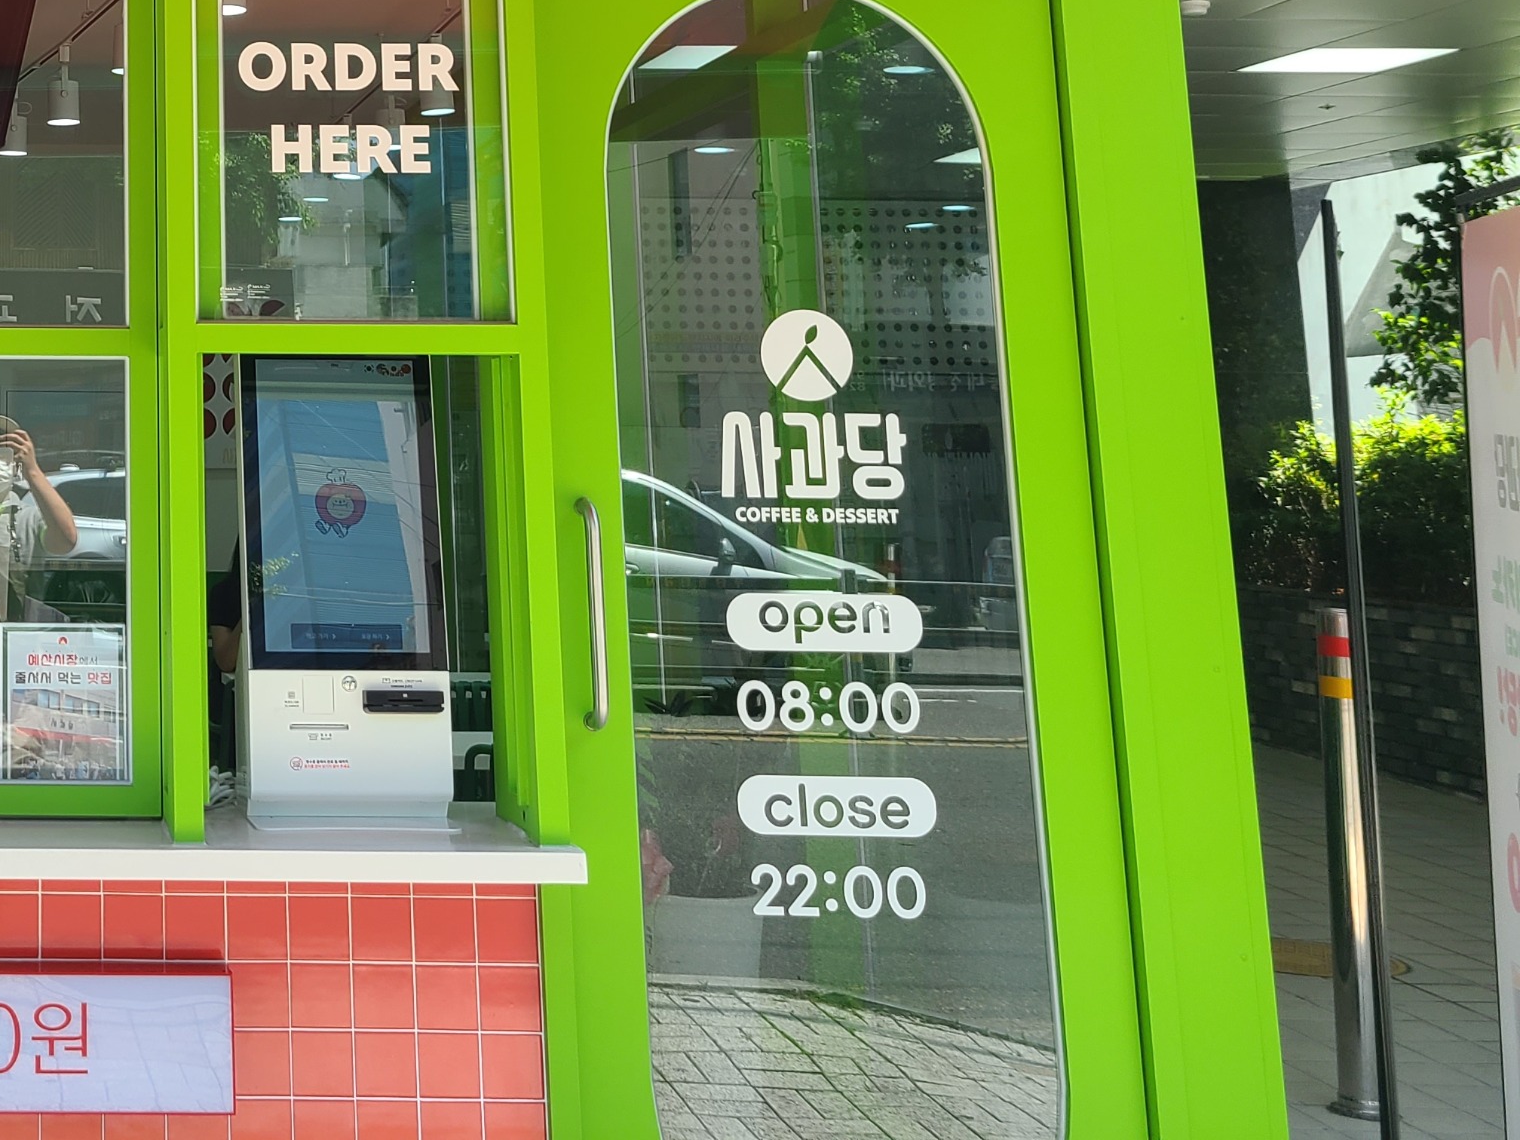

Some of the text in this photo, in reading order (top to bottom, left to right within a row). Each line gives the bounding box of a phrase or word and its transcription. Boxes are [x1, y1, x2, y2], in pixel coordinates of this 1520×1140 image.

[238, 41, 460, 92] ORDER
[270, 124, 432, 174] HERE
[721, 411, 906, 500] 사과당
[735, 507, 900, 524] COFFEE & DESSERT
[758, 595, 891, 644] open
[15, 671, 112, 684] 줄서서 먹는 맛집
[27, 653, 98, 667] 예산시장에서
[737, 680, 921, 734] 08:00
[764, 784, 911, 828] close
[751, 864, 926, 919] 22:00
